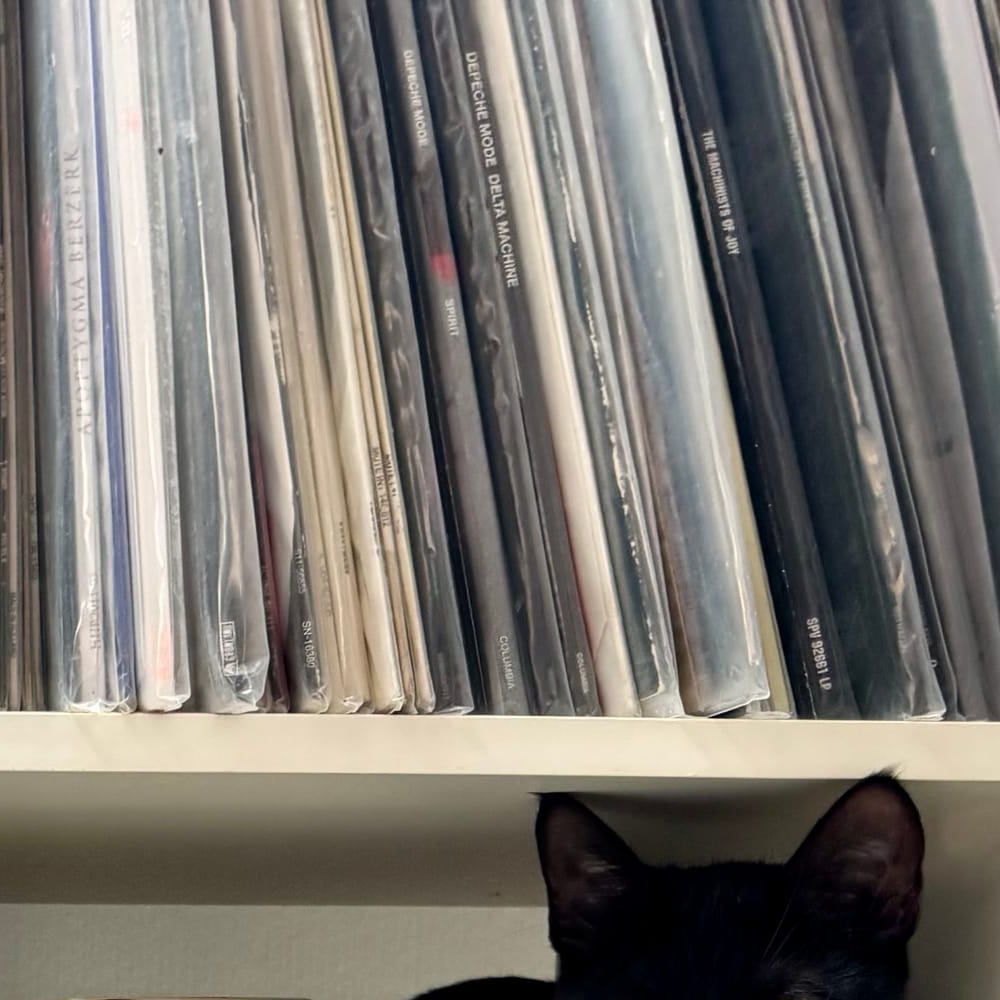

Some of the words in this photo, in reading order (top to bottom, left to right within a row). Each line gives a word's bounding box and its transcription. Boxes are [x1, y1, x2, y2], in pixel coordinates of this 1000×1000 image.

[403, 50, 422, 107] DEPECHE
[465, 51, 489, 121] DEPECHE
[412, 109, 429, 148] MODE
[478, 123, 498, 167] MODE
[702, 130, 717, 152] THE
[62, 147, 83, 263] BERZERK
[487, 174, 507, 219] DELTA
[706, 152, 732, 217] MACHINISTS
[721, 219, 736, 232] OF
[724, 235, 740, 256] JOY
[496, 221, 519, 288] MACHINE
[444, 298, 459, 337] SPIRIT
[499, 635, 515, 690] COLUMBIA
[806, 617, 823, 639] SPV
[818, 676, 833, 691] LP
